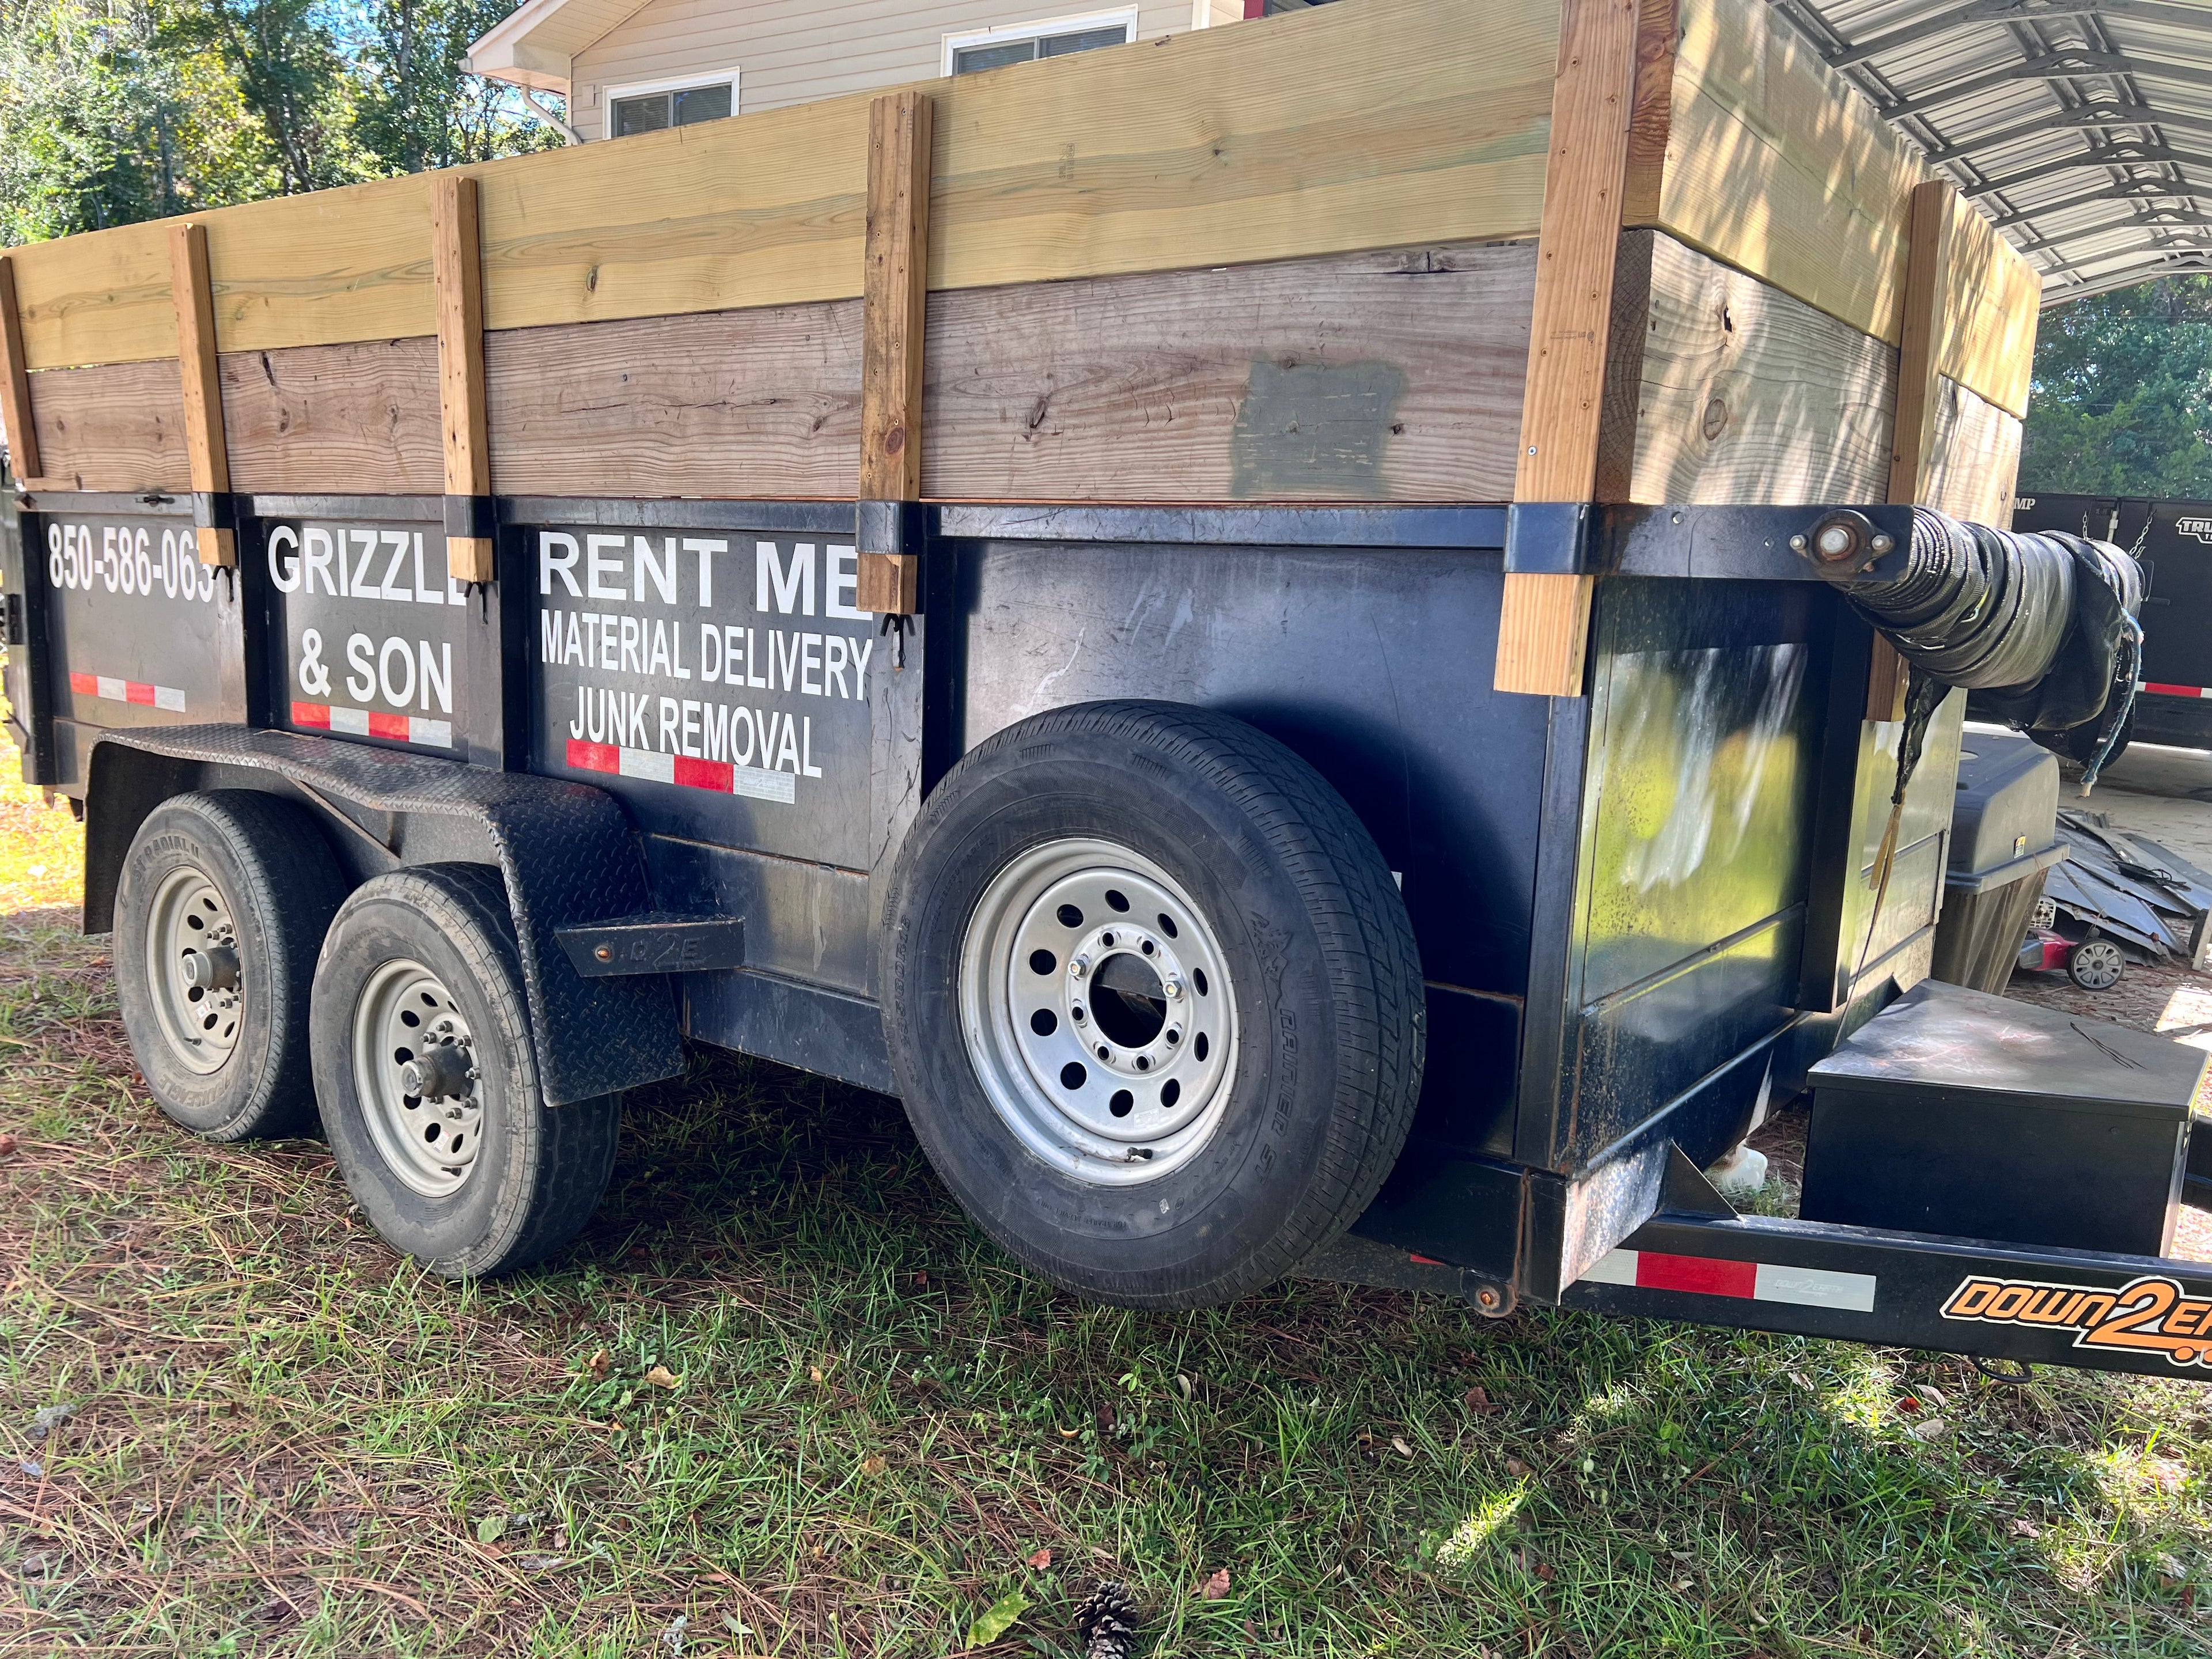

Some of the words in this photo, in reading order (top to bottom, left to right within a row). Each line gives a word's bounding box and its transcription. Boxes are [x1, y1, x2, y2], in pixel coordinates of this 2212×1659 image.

[539, 531, 728, 607] RENT
[756, 541, 873, 621] ME
[298, 628, 332, 698] &
[346, 632, 453, 714] SON
[540, 609, 691, 680] MATERIAL
[700, 623, 873, 700] DELIVERY
[569, 685, 650, 751] JUNK
[659, 696, 822, 779] REMOVAL
[143, 836, 190, 863] RADIAL
[1270, 1008, 1299, 1139] RAINIER
